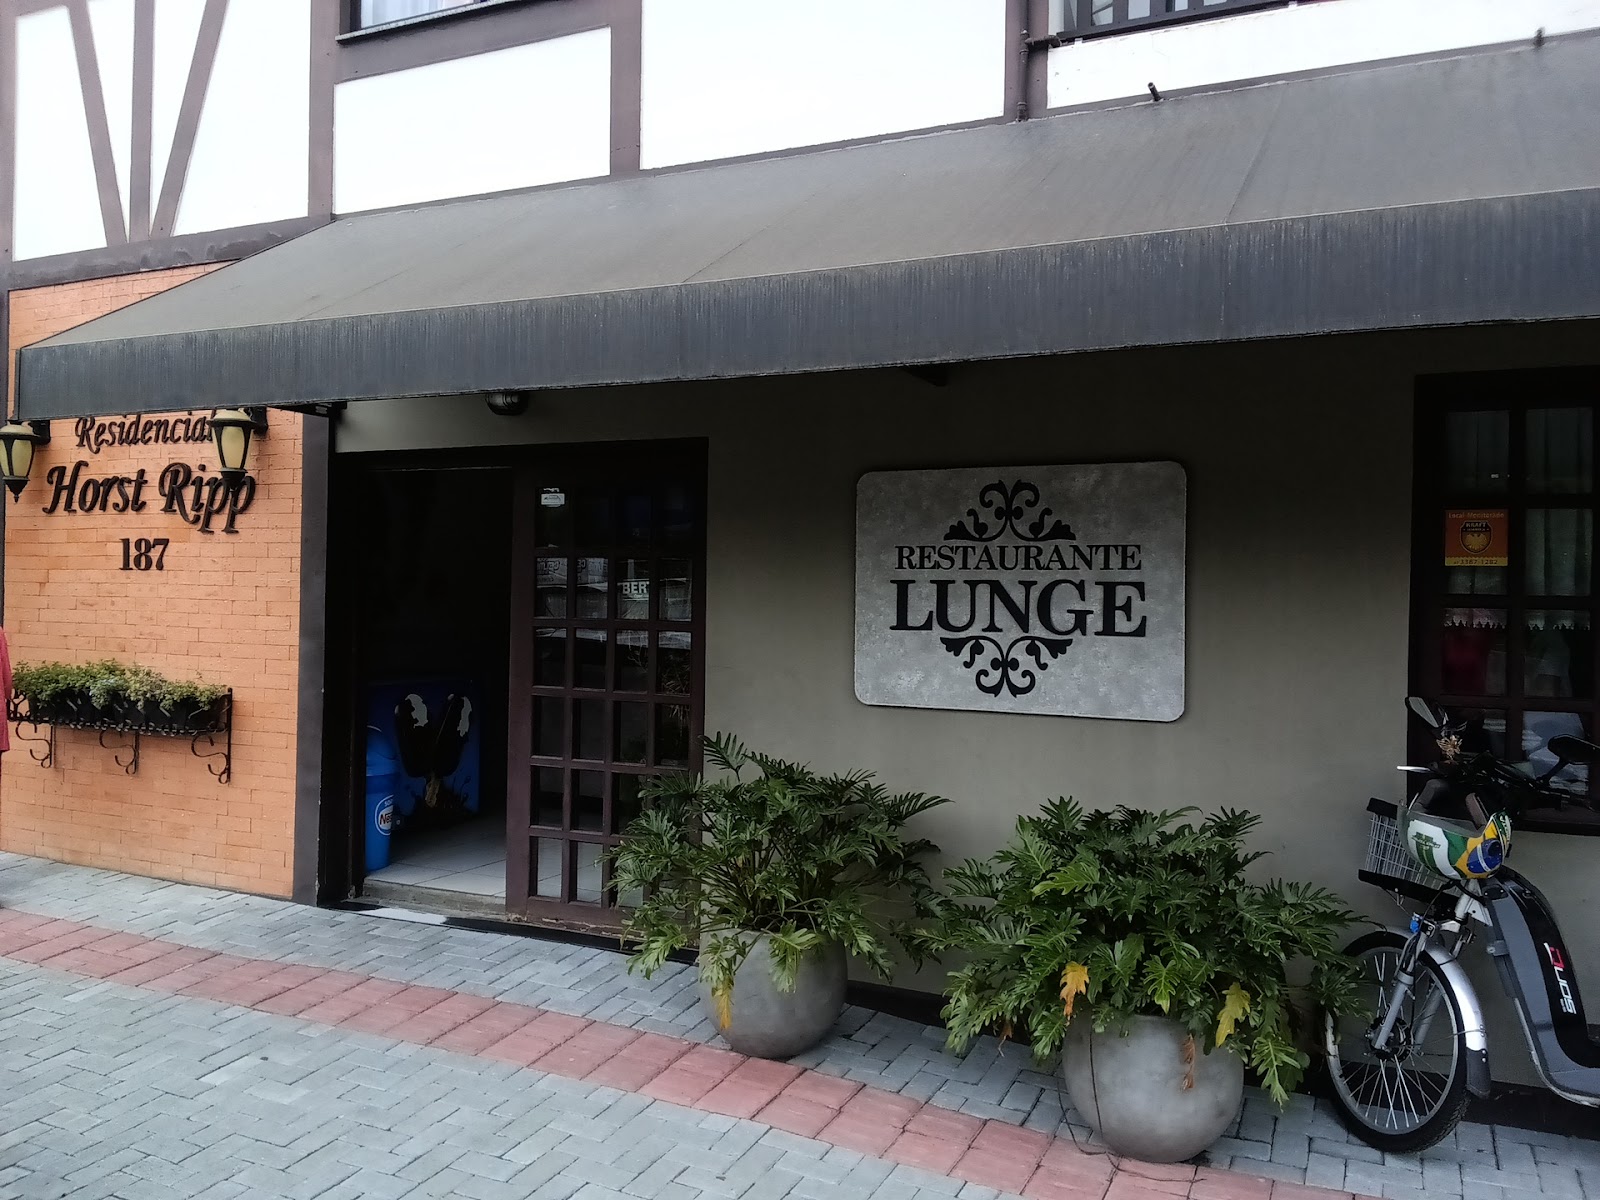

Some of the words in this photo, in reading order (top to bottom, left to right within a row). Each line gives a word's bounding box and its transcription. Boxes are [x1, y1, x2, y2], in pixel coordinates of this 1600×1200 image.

[42, 460, 149, 514] Horst
[158, 462, 256, 534] Ripp
[119, 538, 170, 571] 187
[894, 544, 1142, 571] RESTAURANTE
[622, 581, 649, 594] BER
[889, 579, 1147, 637] LUNGE
